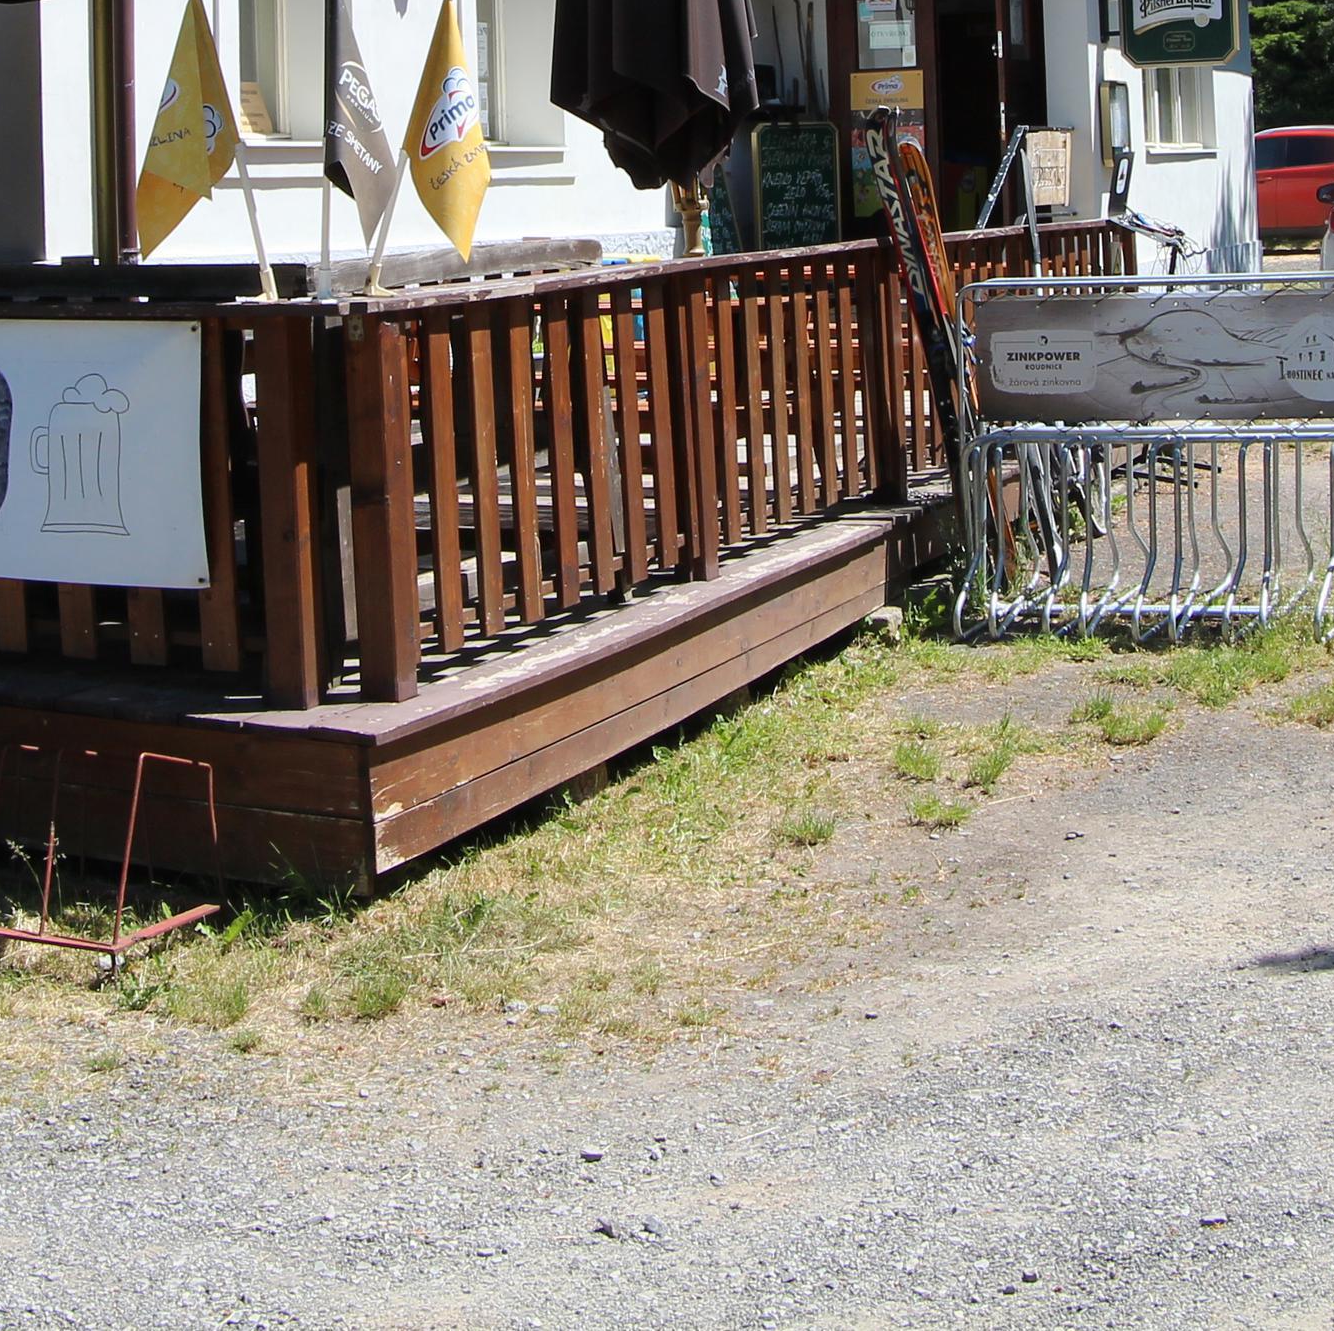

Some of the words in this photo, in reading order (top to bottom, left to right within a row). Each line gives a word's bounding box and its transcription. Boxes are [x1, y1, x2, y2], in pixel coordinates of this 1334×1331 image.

[338, 68, 382, 122] PEGA
[428, 93, 476, 141] Prima
[344, 130, 384, 175] SMETANY
[428, 155, 465, 190] ČESKÁ
[866, 128, 926, 294] DYNASTAR
[1007, 352, 1081, 362] ZINKPOWER
[1025, 363, 1063, 371] ROUDNICE
[1008, 376, 1040, 387] žárová
[1042, 375, 1082, 387] zinkovna
